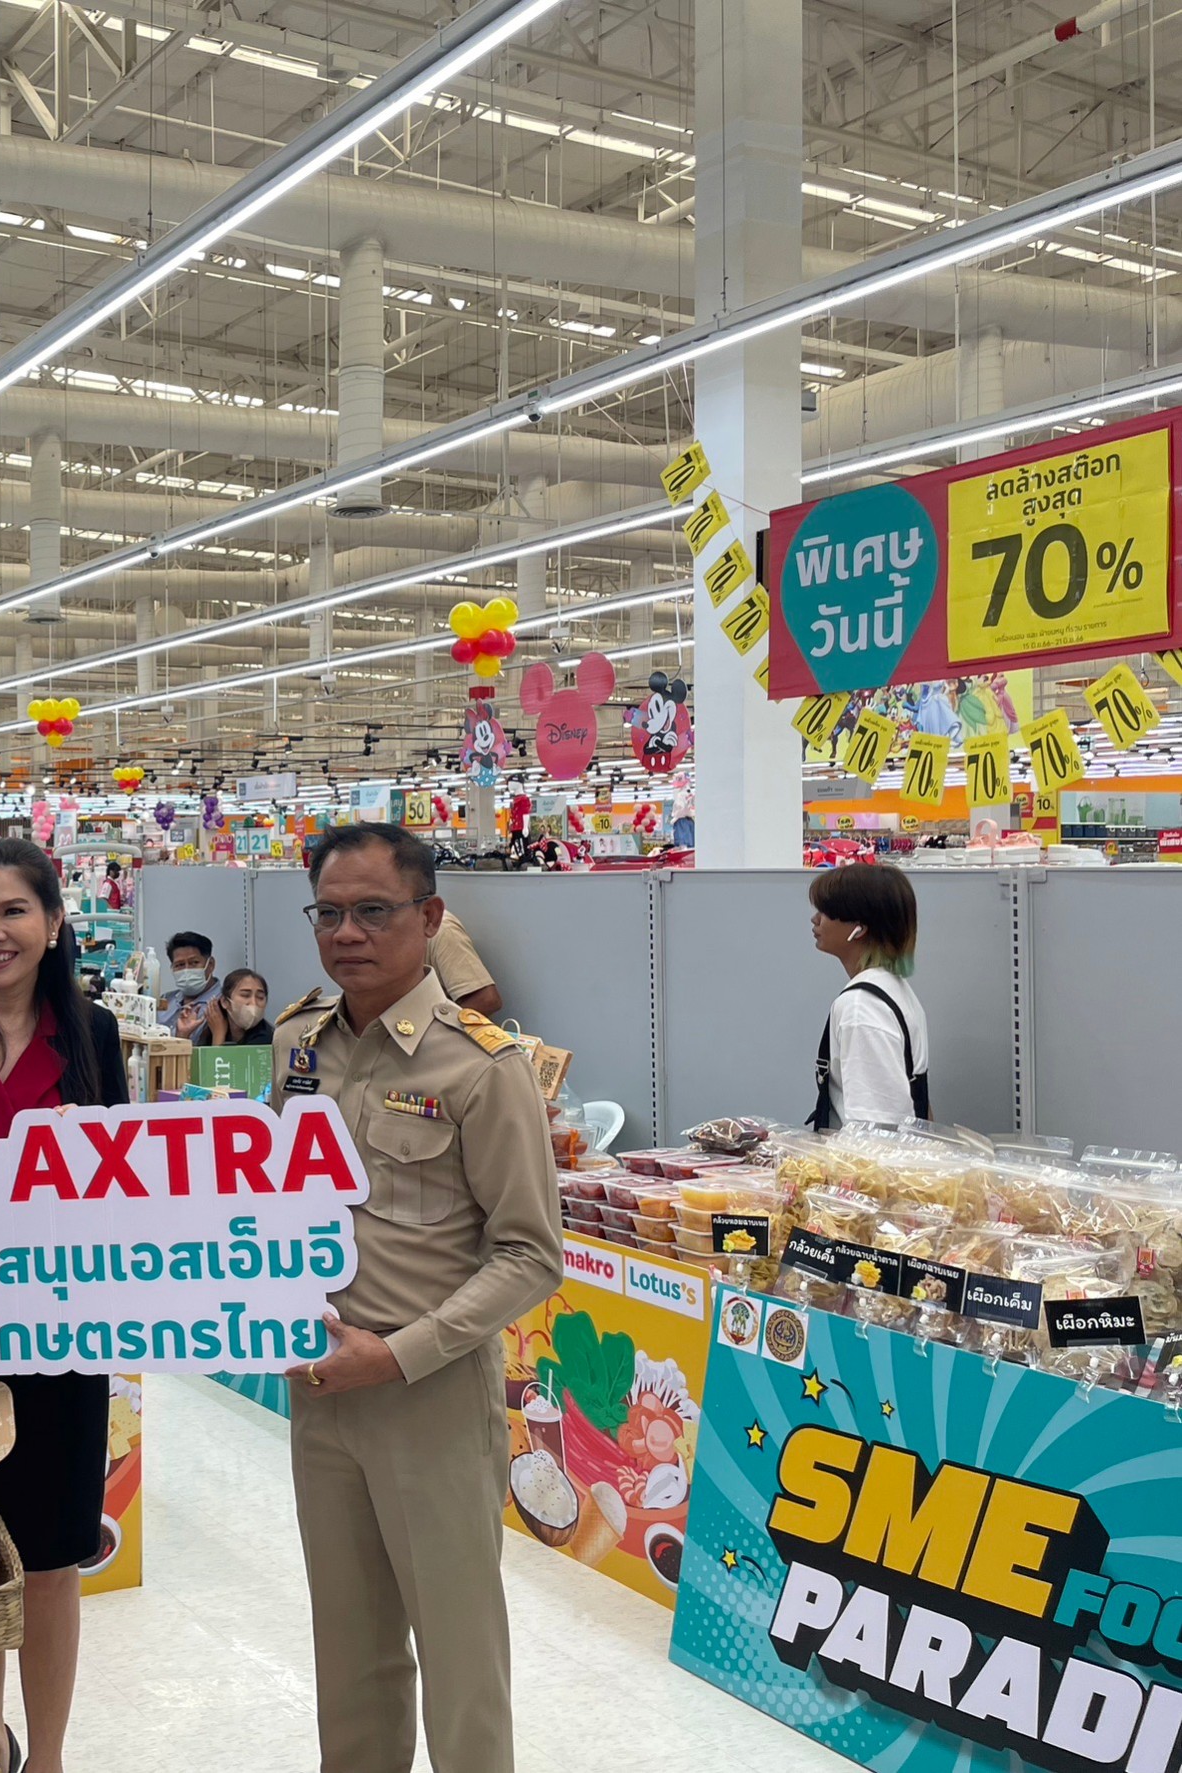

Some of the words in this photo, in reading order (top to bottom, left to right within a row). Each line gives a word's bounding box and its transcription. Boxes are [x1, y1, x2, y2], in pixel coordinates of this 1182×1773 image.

[665, 451, 695, 502] 70%
[687, 501, 714, 553] 70%
[1022, 487, 1082, 526] สูงสุด
[707, 551, 737, 602] 70%
[795, 526, 923, 587] พิเศษ
[971, 523, 1143, 629] 70%
[726, 597, 762, 650] 70%
[809, 573, 911, 658] วันนี้
[1095, 688, 1153, 743] 70%
[848, 725, 879, 777] 70%
[906, 749, 938, 798] 70%
[968, 751, 1007, 801] 70%
[1030, 733, 1079, 786] 70%
[408, 801, 428, 820] 50
[251, 834, 269, 850] 21
[10, 1111, 358, 1202] AXTRA
[563, 1249, 614, 1279] makro
[629, 1266, 697, 1305] Lotus's
[967, 1286, 1033, 1311] เผือกเค็ม
[1055, 1311, 1136, 1331] เผือกหิมะ
[768, 1426, 1080, 1619] SME
